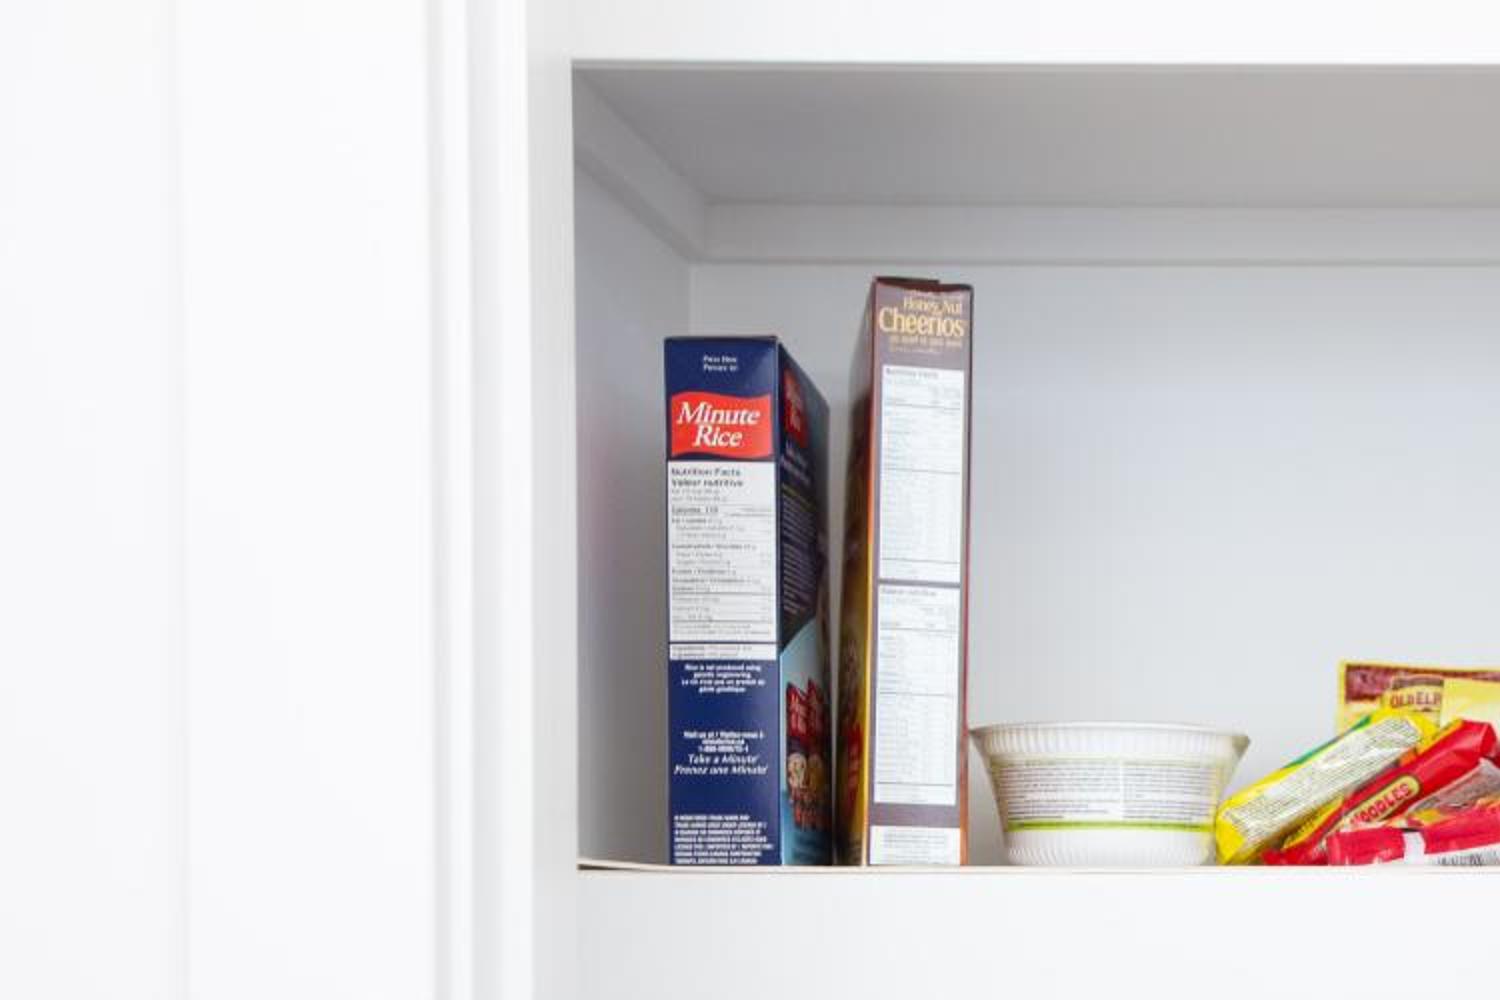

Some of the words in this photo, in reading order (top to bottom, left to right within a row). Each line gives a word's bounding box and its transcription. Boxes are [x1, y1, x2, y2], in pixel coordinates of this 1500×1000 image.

[878, 306, 965, 337] Cheerios
[677, 401, 761, 426] Minute
[694, 425, 744, 448] Rice
